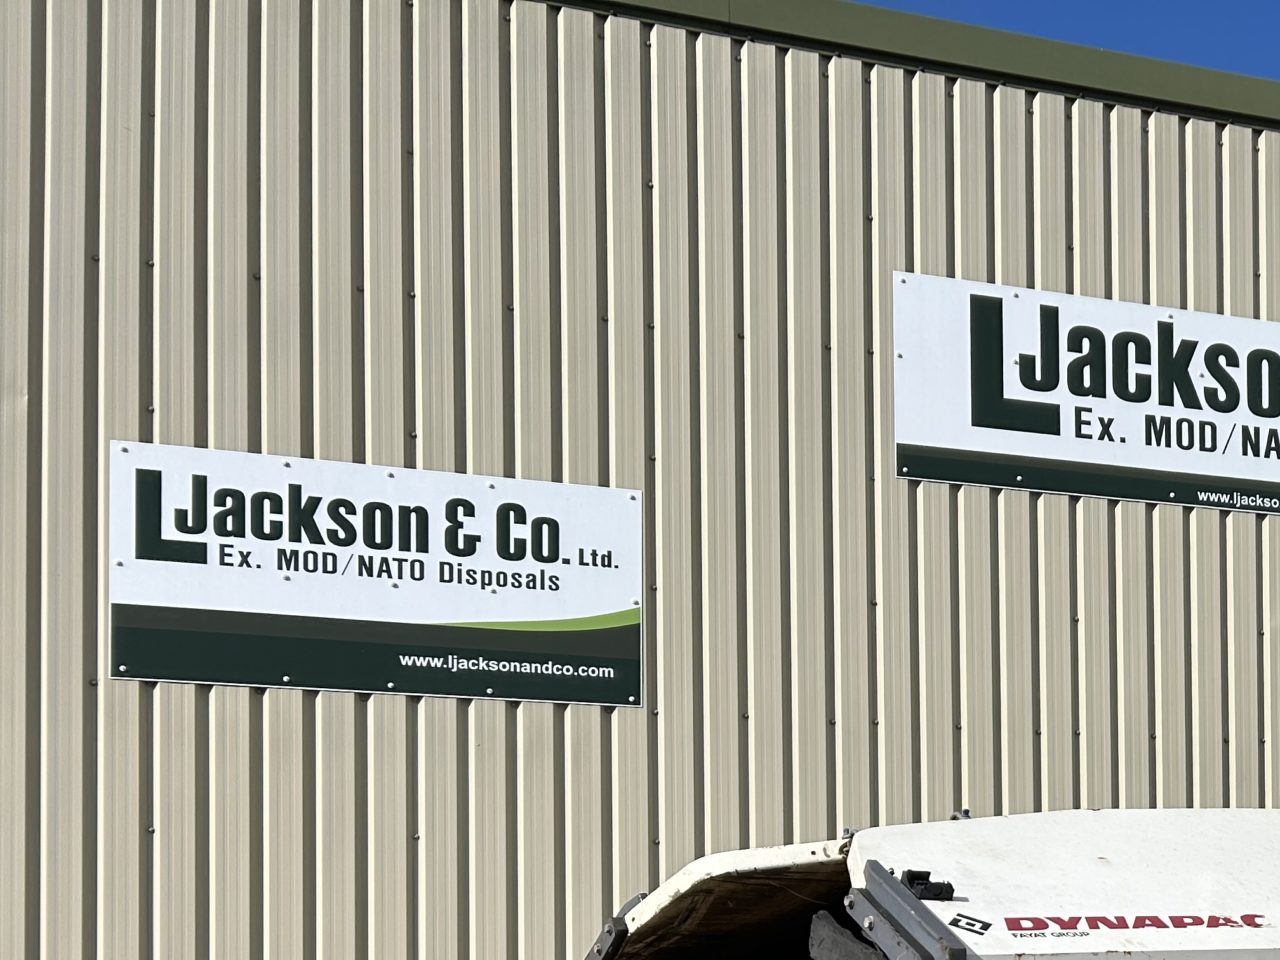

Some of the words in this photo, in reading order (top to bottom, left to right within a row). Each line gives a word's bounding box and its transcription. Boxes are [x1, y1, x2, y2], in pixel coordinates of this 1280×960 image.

[1075, 406, 1127, 444] Ex.
[444, 498, 481, 558] &
[496, 502, 571, 565] Co.
[578, 548, 619, 570] Ltd.
[219, 543, 262, 570] Ex.
[277, 548, 425, 582] MOD/NATO
[439, 561, 561, 592] Disposals
[399, 654, 615, 679] www.ljacksonandco.com
[1003, 914, 1268, 931] DYNAPAC
[1050, 931, 1091, 939] GROUP
